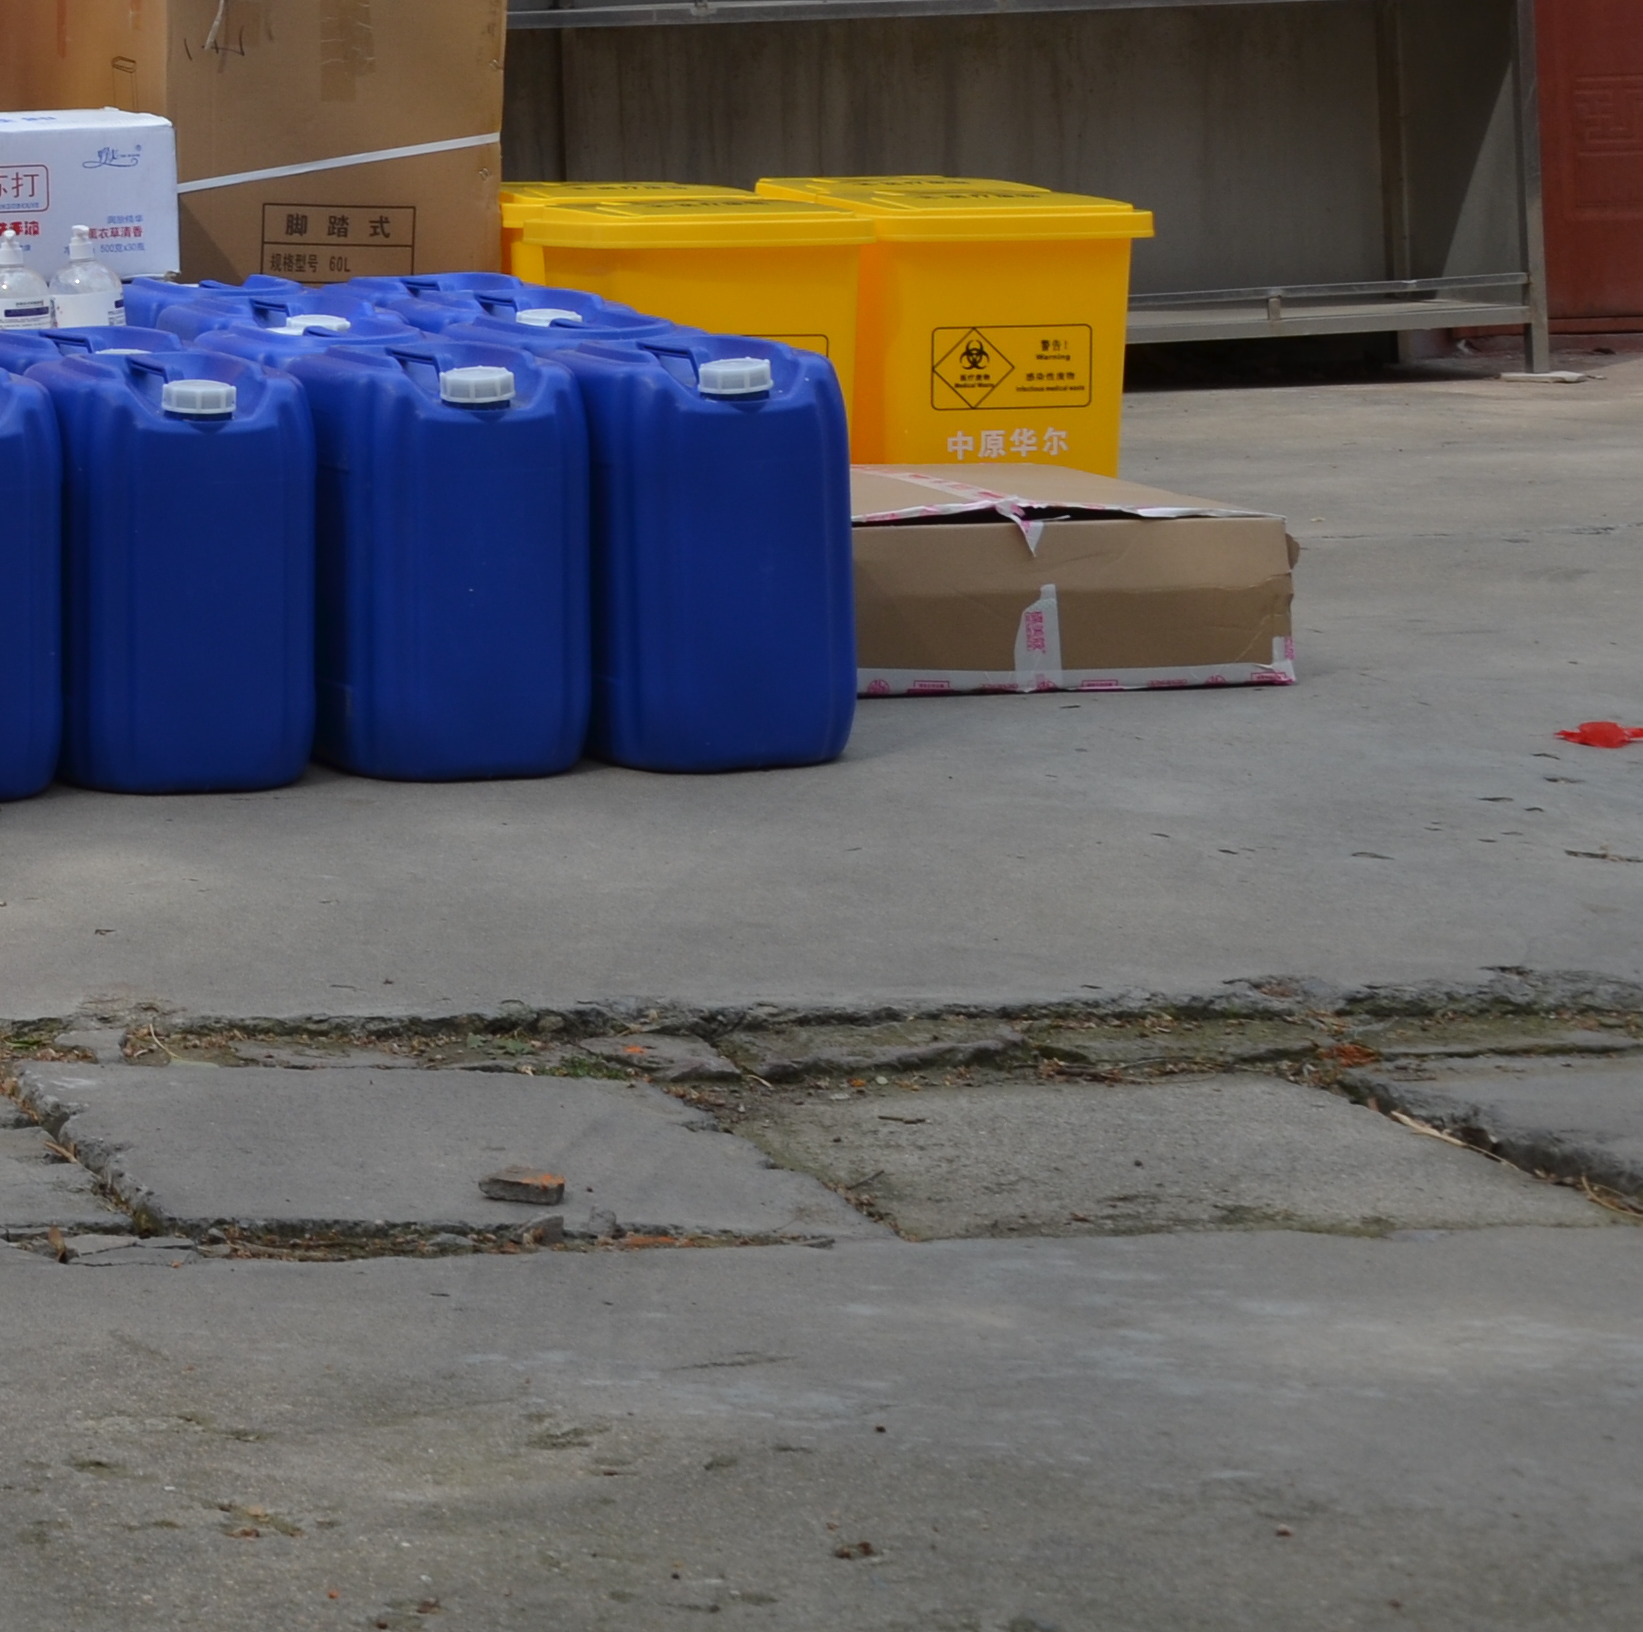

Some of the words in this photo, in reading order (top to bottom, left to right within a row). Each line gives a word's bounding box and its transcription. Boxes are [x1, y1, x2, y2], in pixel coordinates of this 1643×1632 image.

[285, 213, 391, 239] 脚踏式
[270, 253, 318, 273] 规格型号
[329, 256, 351, 273] 60L
[947, 426, 1069, 461] 中原华尔
